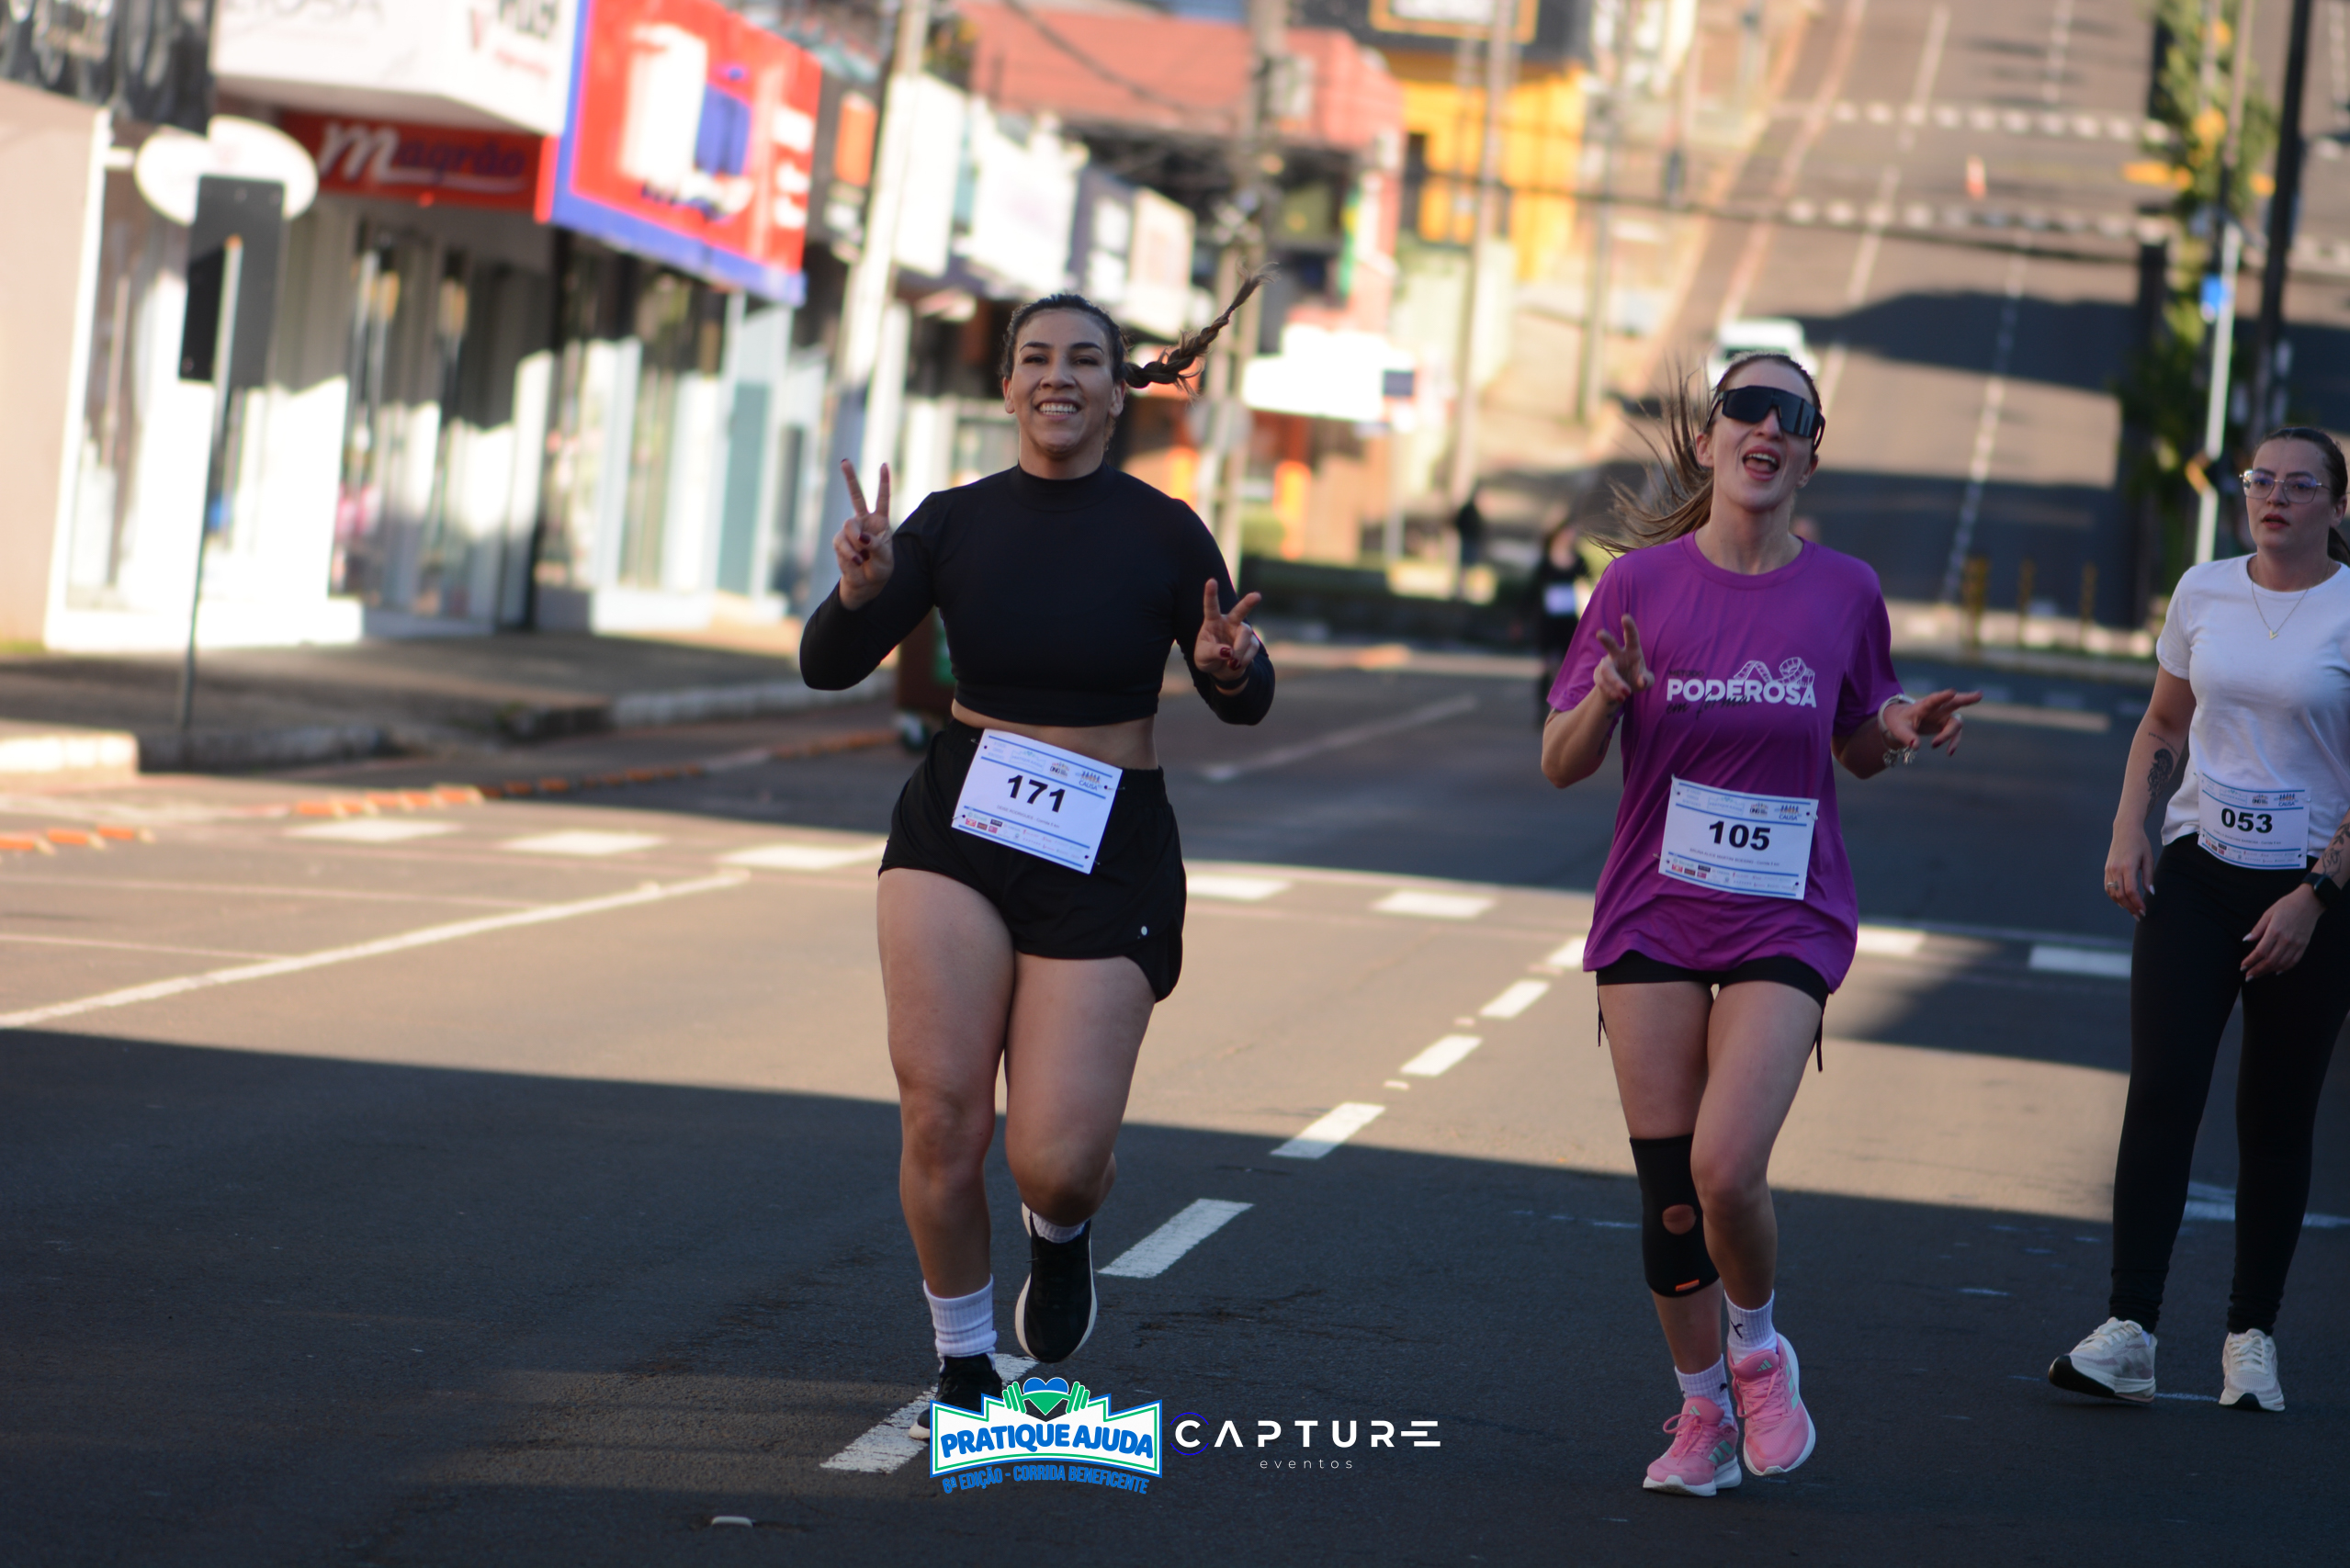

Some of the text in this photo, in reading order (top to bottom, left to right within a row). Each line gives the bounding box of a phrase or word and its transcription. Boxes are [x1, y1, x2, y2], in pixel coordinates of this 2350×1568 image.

[1666, 679, 1817, 708] PODEROSA
[1666, 691, 1753, 720] em forma
[1007, 774, 1066, 813] 171
[1079, 777, 1098, 791] CAUSA
[2221, 807, 2273, 833] 053
[1709, 820, 1771, 851] 105
